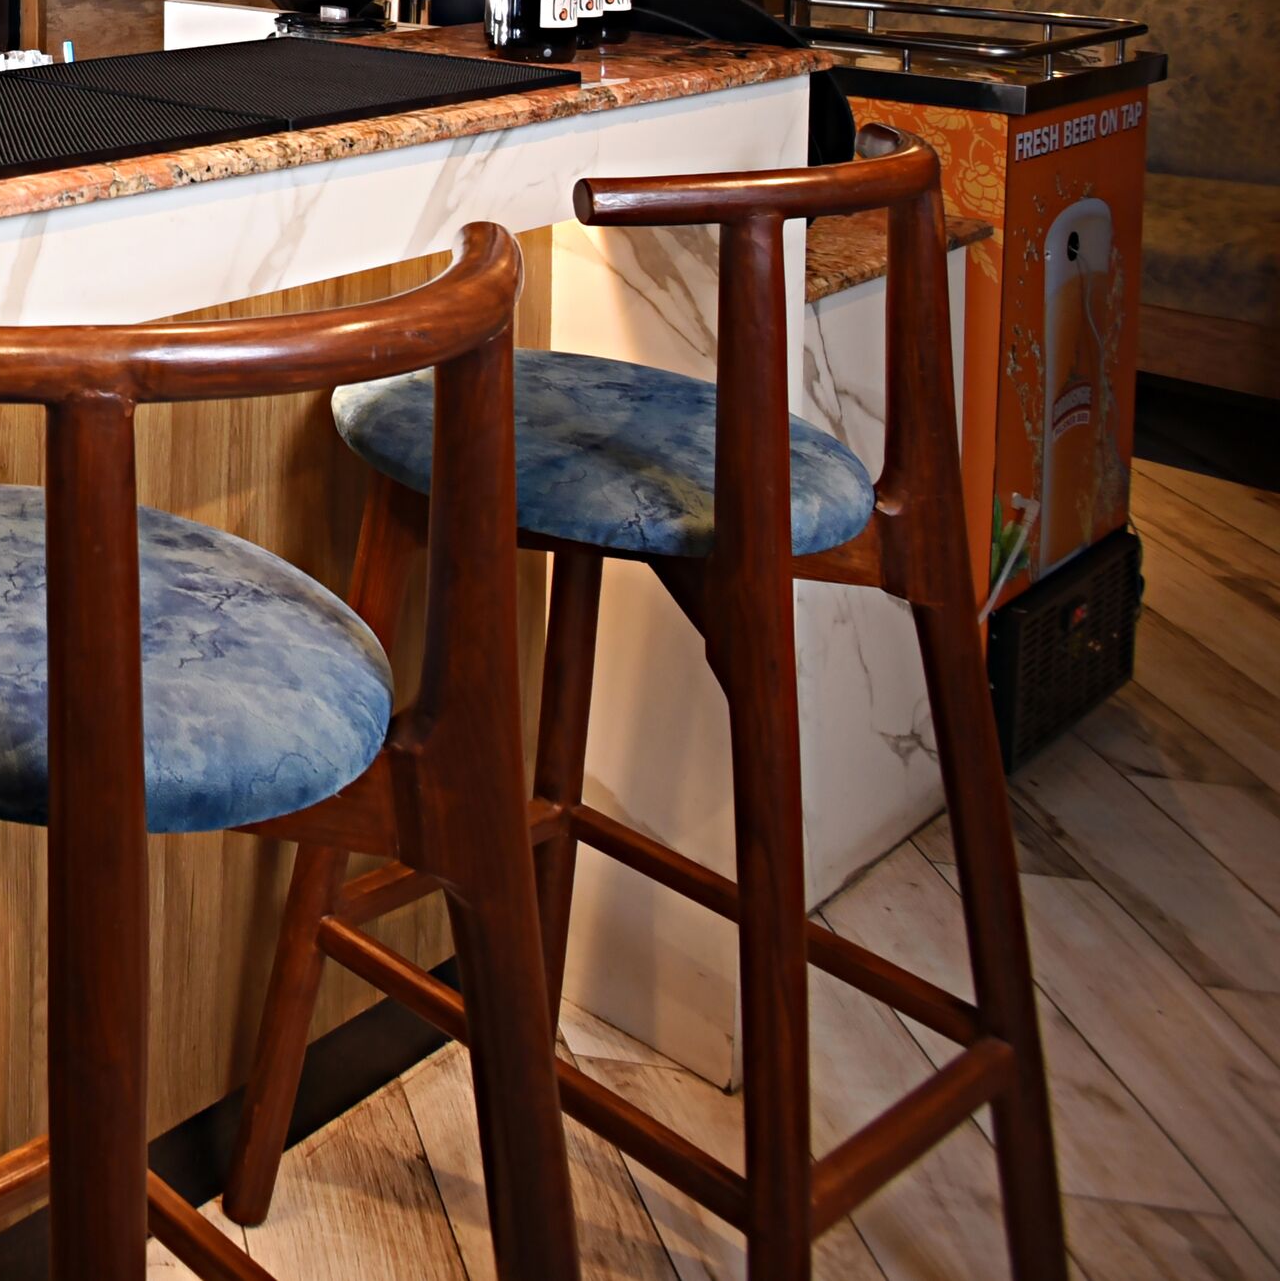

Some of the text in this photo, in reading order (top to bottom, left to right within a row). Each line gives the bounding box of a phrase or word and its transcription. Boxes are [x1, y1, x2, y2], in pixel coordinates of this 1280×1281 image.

[1015, 100, 1143, 162] FRESH BEER ON TAP
